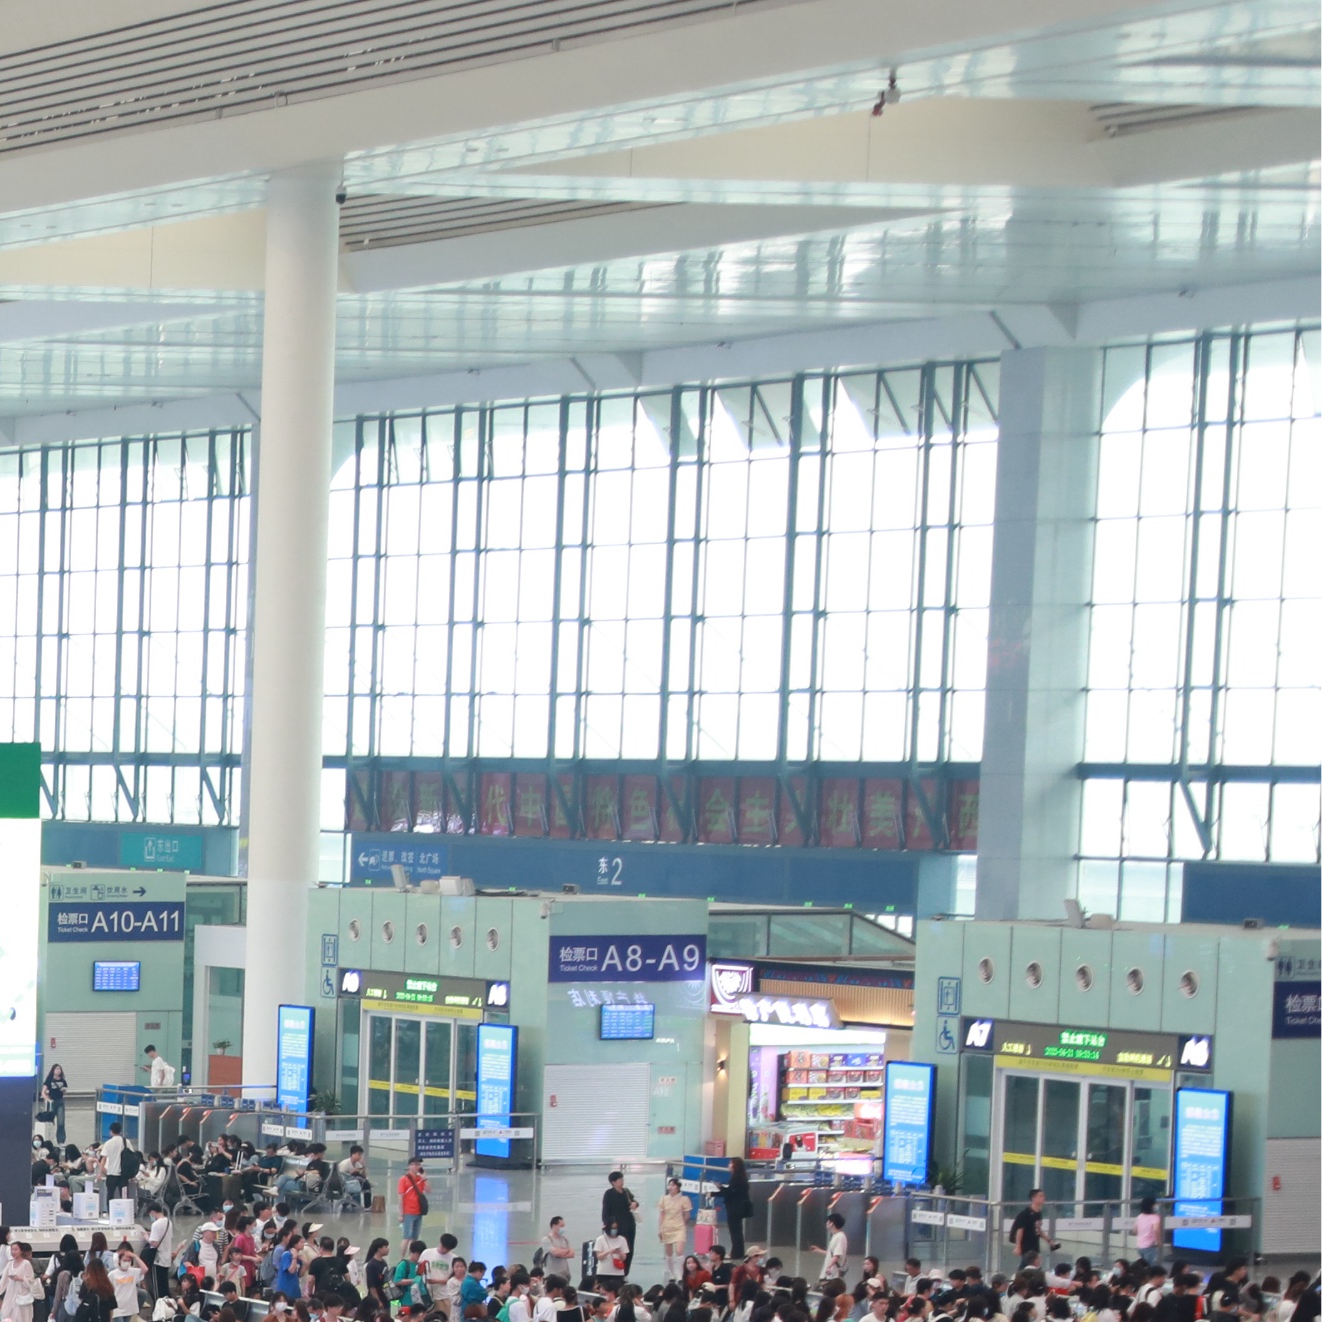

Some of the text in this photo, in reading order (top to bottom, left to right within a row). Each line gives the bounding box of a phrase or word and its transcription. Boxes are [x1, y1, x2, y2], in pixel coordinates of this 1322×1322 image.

[598, 856, 622, 885] 东 2
[57, 910, 179, 933] 检票口 A10-A11
[559, 944, 700, 972] 检票口 A8-A9
[578, 964, 598, 972] Check
[1285, 994, 1322, 1013] 检票
